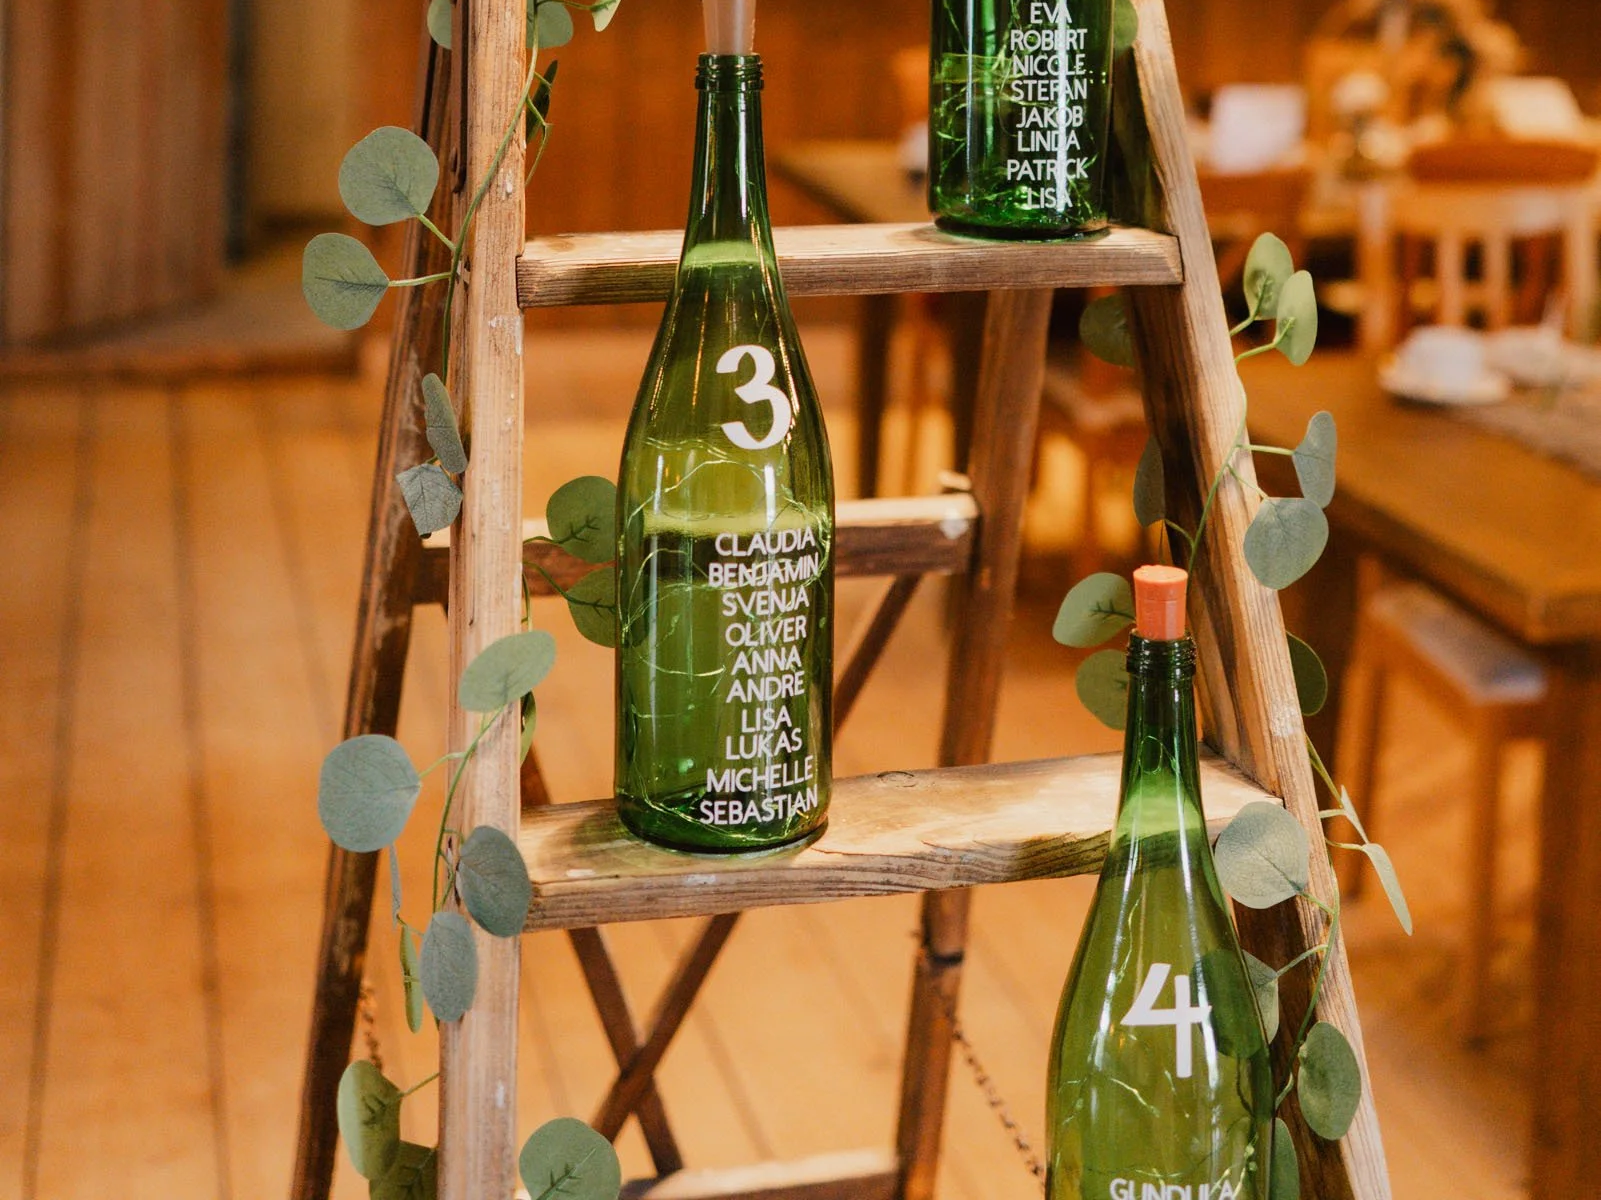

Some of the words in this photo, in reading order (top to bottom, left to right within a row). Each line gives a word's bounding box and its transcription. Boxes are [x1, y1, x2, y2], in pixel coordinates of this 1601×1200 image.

[1030, 2, 1072, 24] EVA
[1010, 28, 1088, 52] ROBERT
[1012, 53, 1086, 77] NICOLE
[1011, 78, 1088, 102] STEFAN
[1016, 105, 1084, 129] JAKOB
[1017, 129, 1081, 152] LINDA
[1026, 187, 1073, 209] LISA
[716, 344, 791, 450] 3
[715, 525, 816, 557] CLAUDIA
[707, 551, 819, 588] BENJAMIN
[722, 585, 810, 617] SVENJA
[725, 615, 807, 647] OLIVER
[731, 645, 802, 676] ANNA
[726, 670, 806, 704] ANDRE
[741, 704, 793, 733] LISA
[726, 727, 803, 760] LUKAS
[706, 755, 814, 793] MICHELLE
[700, 783, 818, 826] SEBASTIAN
[1120, 963, 1212, 1078] 4
